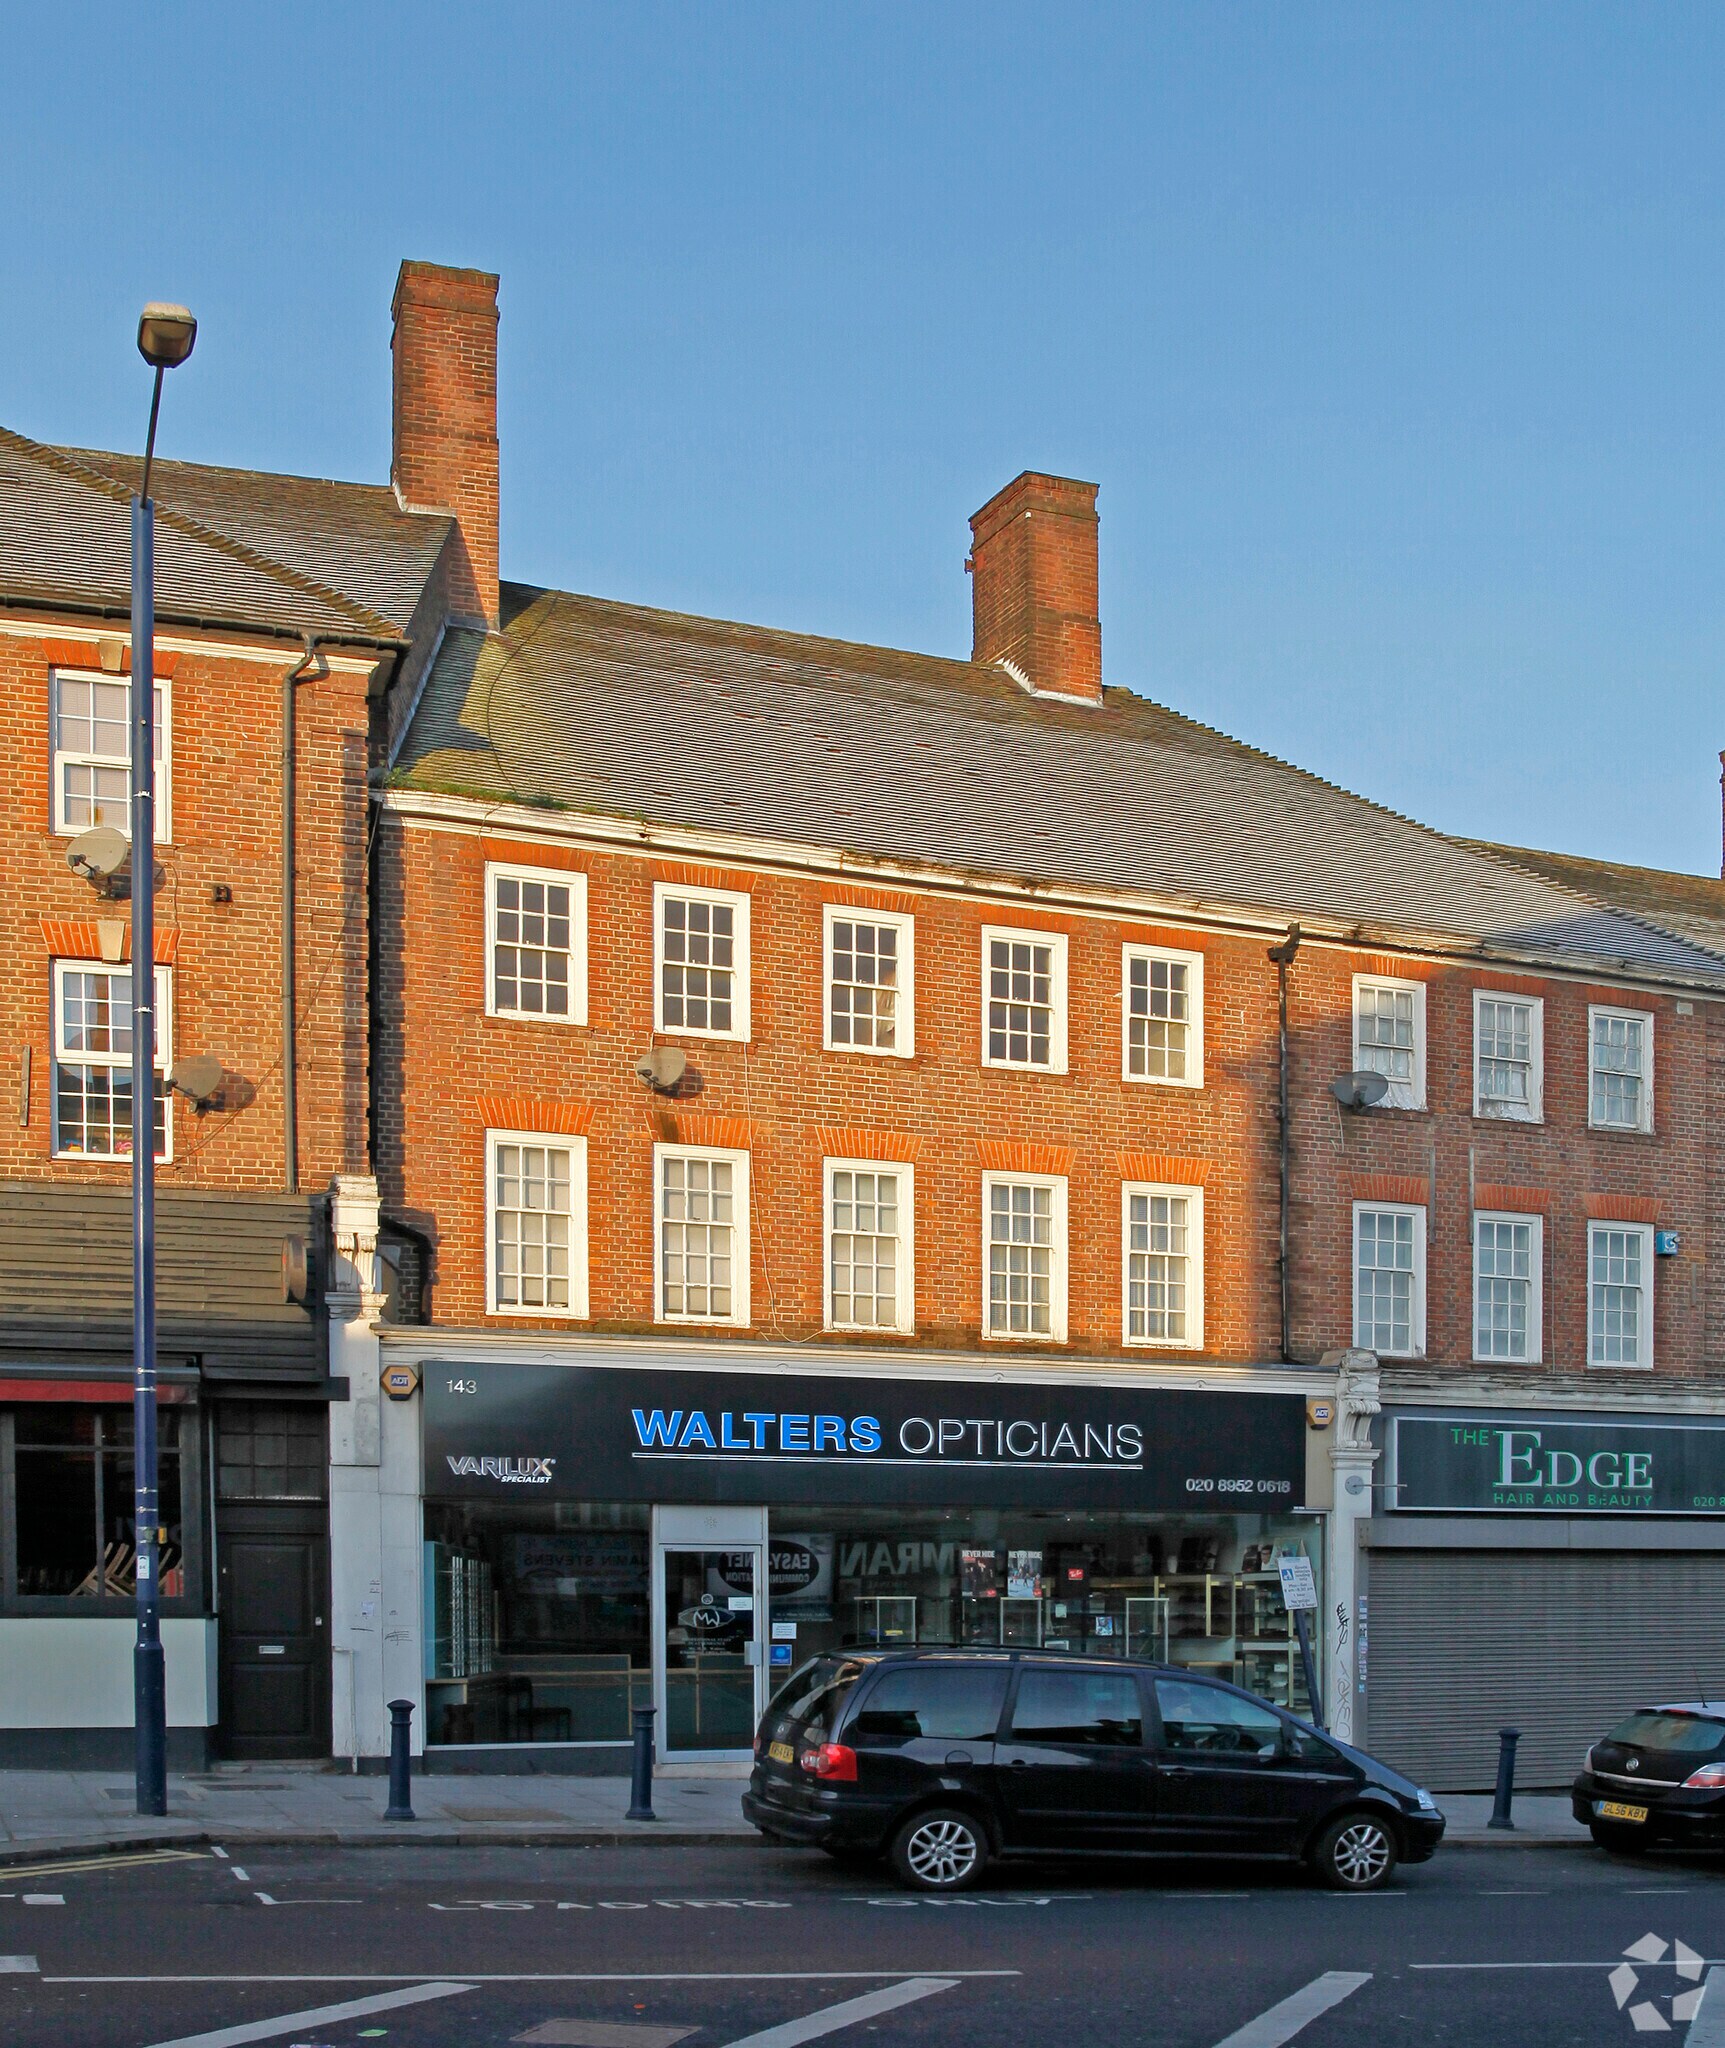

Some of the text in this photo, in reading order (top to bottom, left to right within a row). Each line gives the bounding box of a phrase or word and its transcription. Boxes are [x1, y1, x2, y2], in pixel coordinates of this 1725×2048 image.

[391, 1375, 409, 1387] ADT
[446, 1379, 478, 1395] 143
[1315, 1408, 1329, 1419] ADT
[631, 1408, 1144, 1460] WALTERS OPTICIANS
[1450, 1428, 1654, 1489] THE EDGE
[446, 1455, 553, 1479] VARILUX
[500, 1474, 552, 1484] SPECIALIST
[1185, 1478, 1291, 1495] 020 8952 0618
[1493, 1492, 1653, 1506] HAIR AND BEAUTY
[1693, 1496, 1715, 1507] 020
[1603, 1802, 1646, 1819] GL56 KBX
[427, 1897, 1055, 1911] LOADING ONLY
